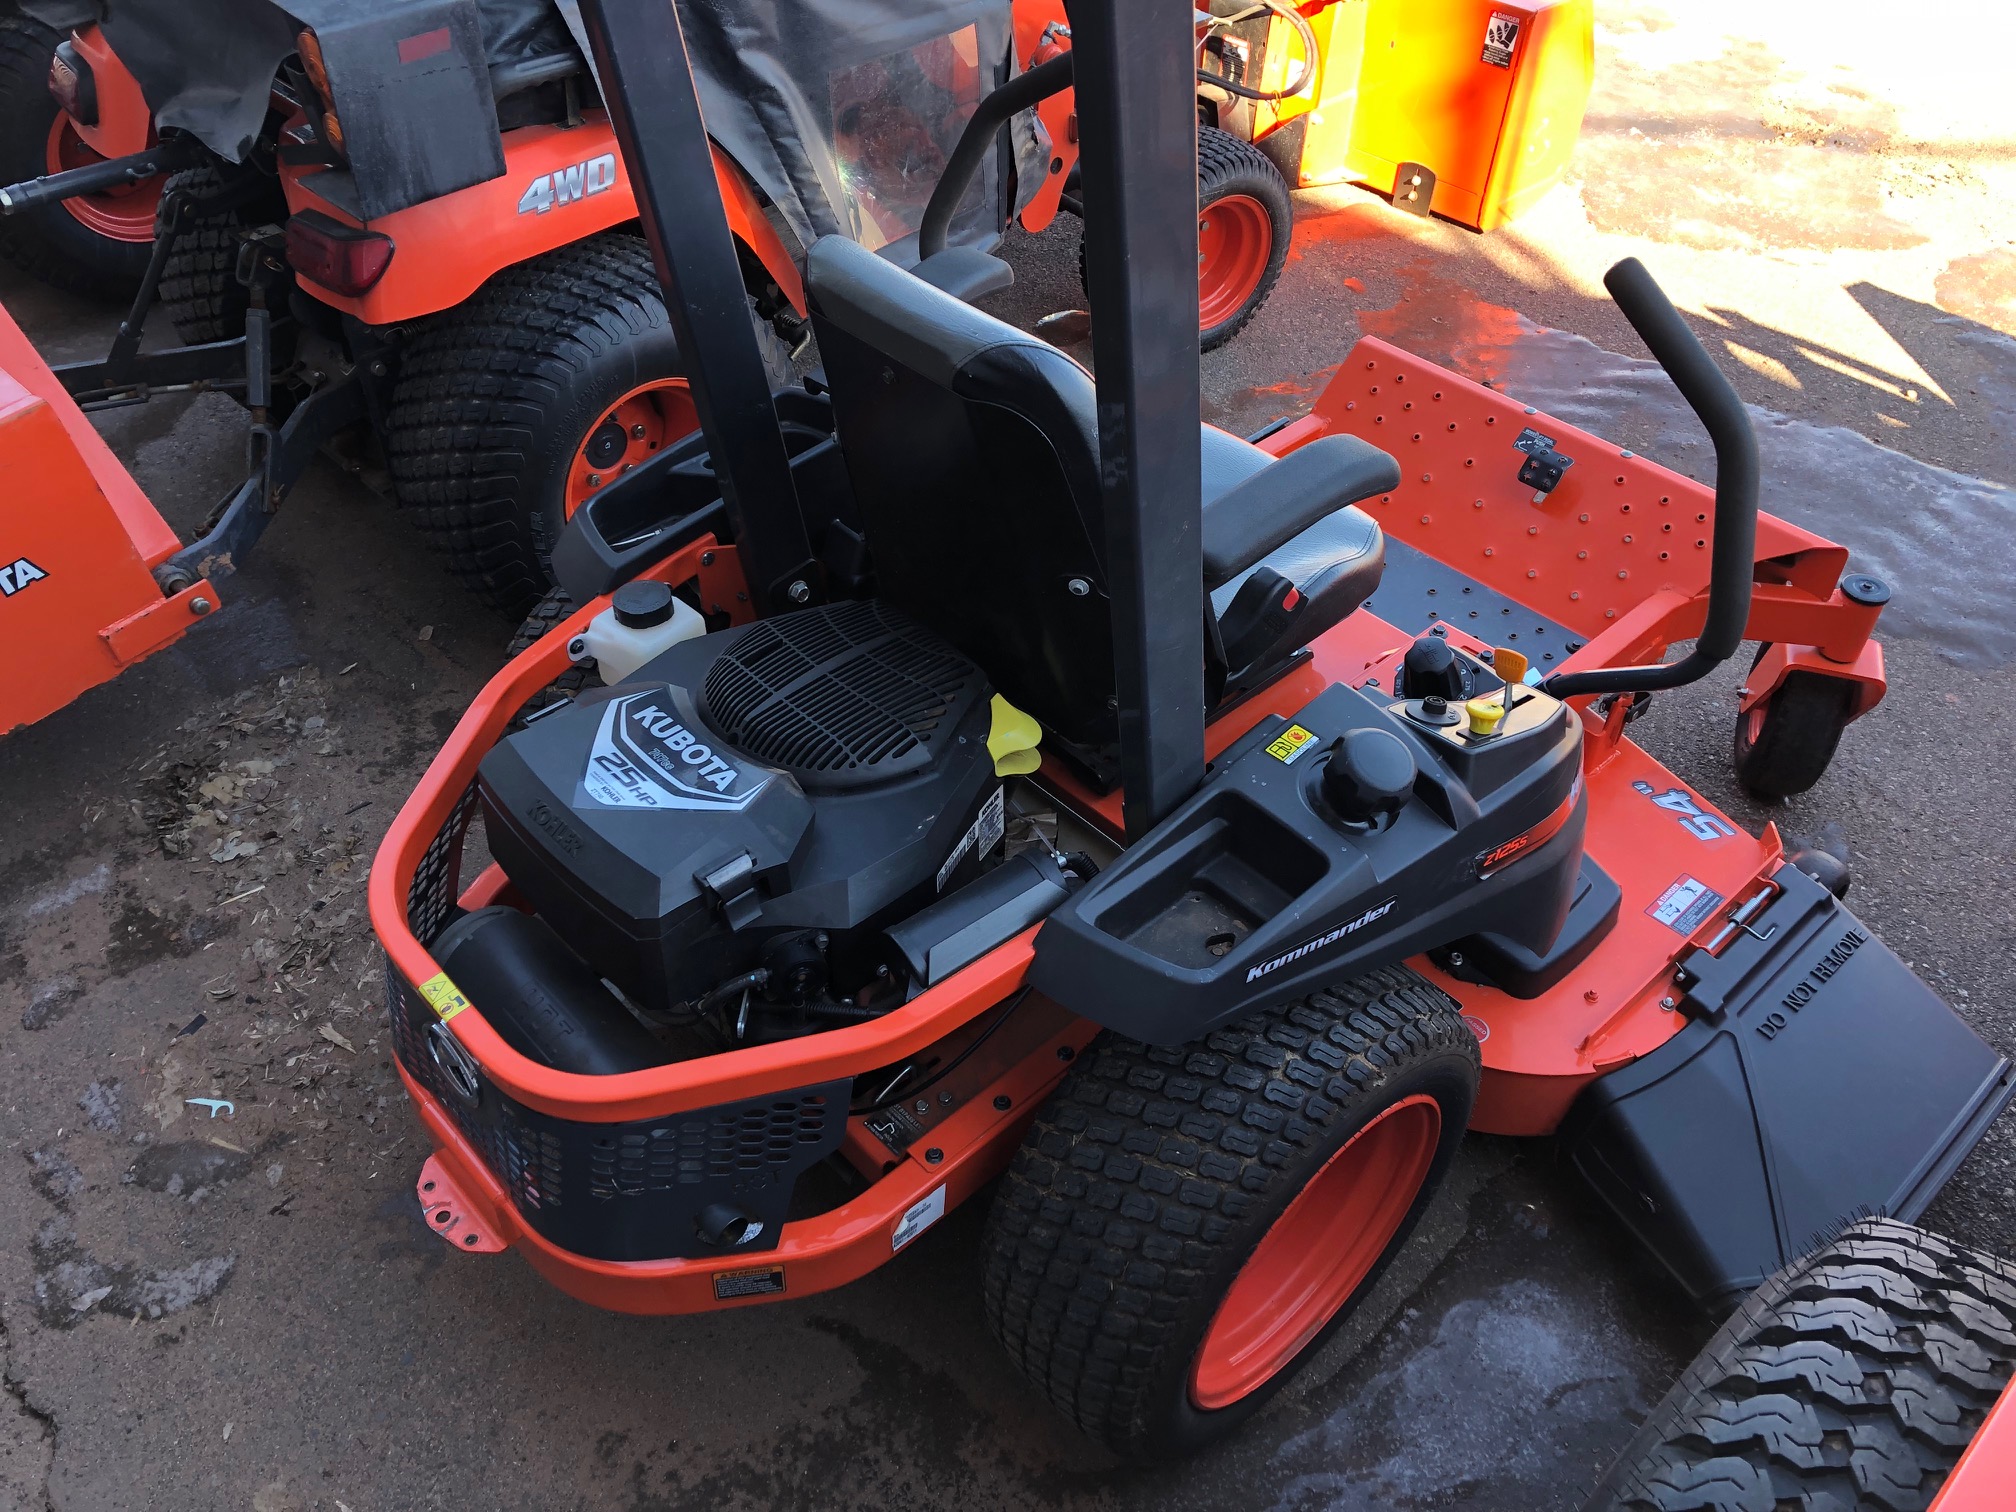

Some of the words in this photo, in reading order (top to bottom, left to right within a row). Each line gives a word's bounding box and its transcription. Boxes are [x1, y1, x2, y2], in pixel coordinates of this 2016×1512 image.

[1497, 12, 1520, 24] DANGER
[518, 153, 617, 215] 4WD
[632, 705, 738, 792] KUBOTA
[601, 785, 622, 804] KOHLER
[981, 792, 1000, 817] KOHLER
[526, 798, 583, 859] KOHLER
[1660, 882, 1681, 903] DANGER
[1245, 900, 1396, 984] Kommander
[1756, 1011, 1787, 1041] DO
[1782, 978, 1818, 1013] NOT
[1810, 927, 1869, 984] REMOVE
[729, 1268, 774, 1277] WARNING
